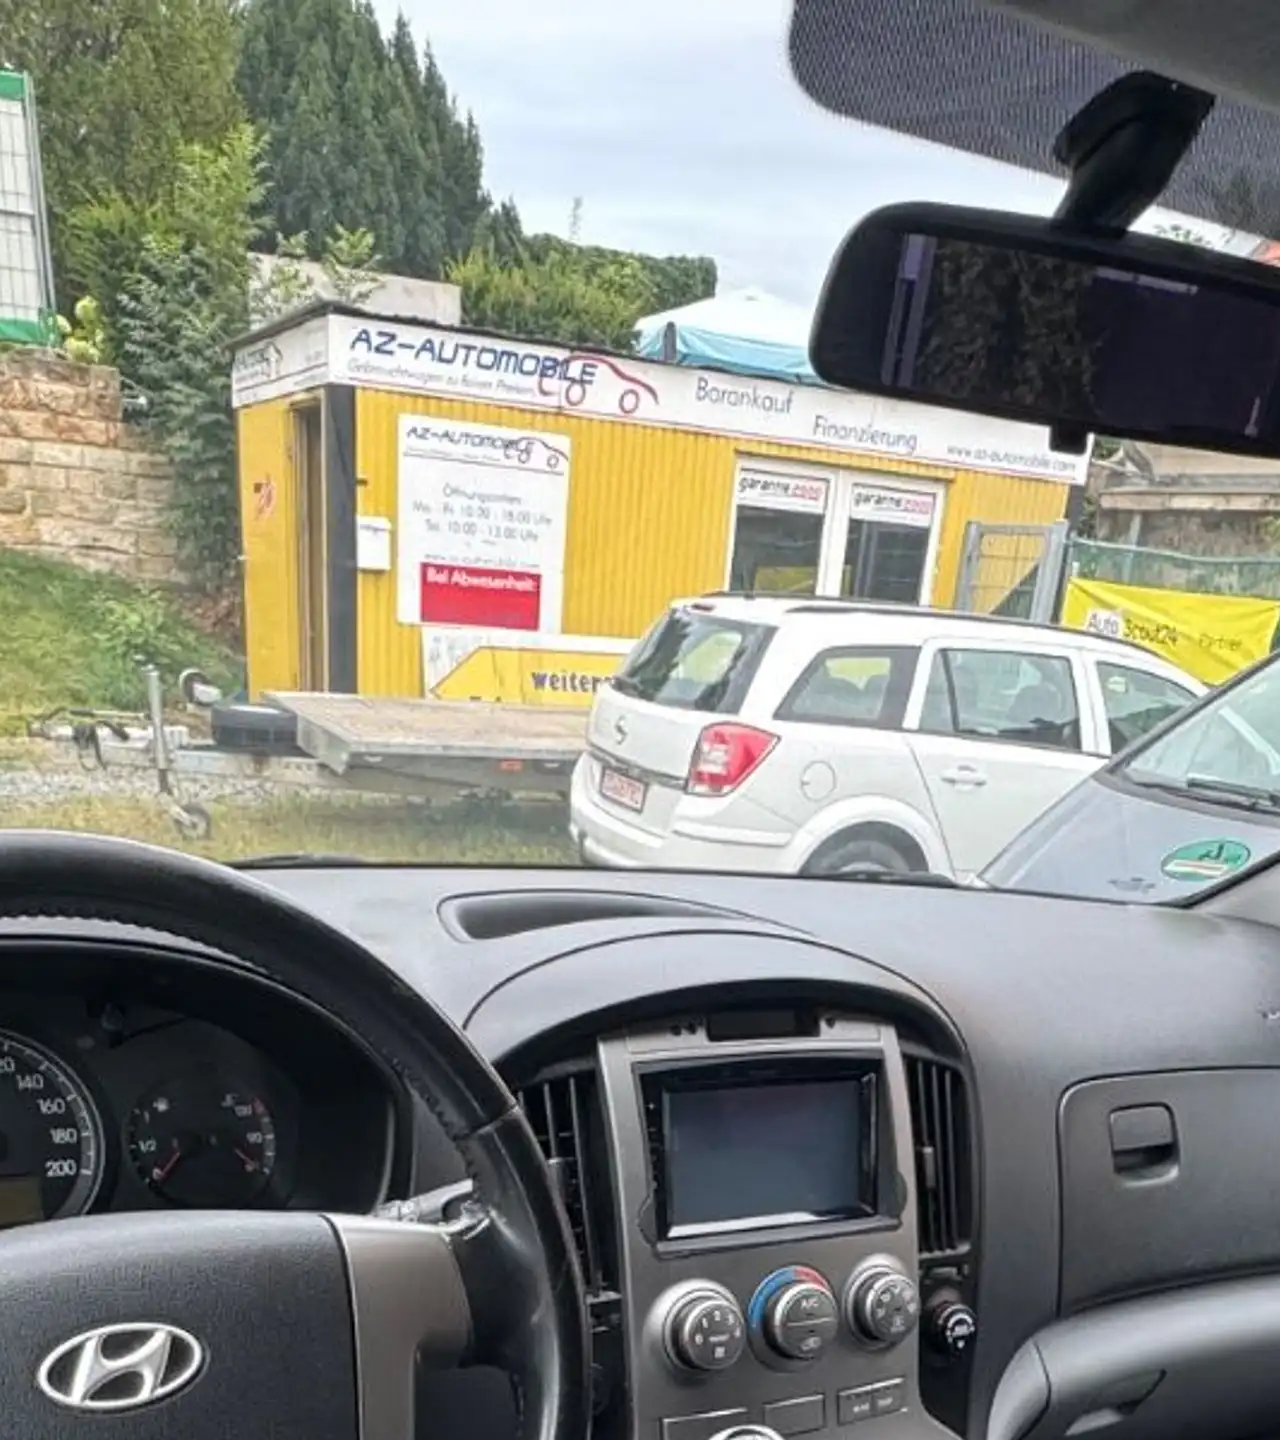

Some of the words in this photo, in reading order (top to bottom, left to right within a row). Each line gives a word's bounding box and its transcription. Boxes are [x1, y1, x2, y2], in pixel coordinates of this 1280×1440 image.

[350, 328, 599, 386] AZ-AUTOMOBILE
[813, 415, 918, 456] Finanzierung
[531, 671, 613, 694] weiter
[16, 1074, 44, 1090] 140
[37, 1098, 66, 1115] 160
[50, 1128, 77, 1145] 180
[45, 1159, 77, 1177] 200
[713, 1310, 721, 1322] 2
